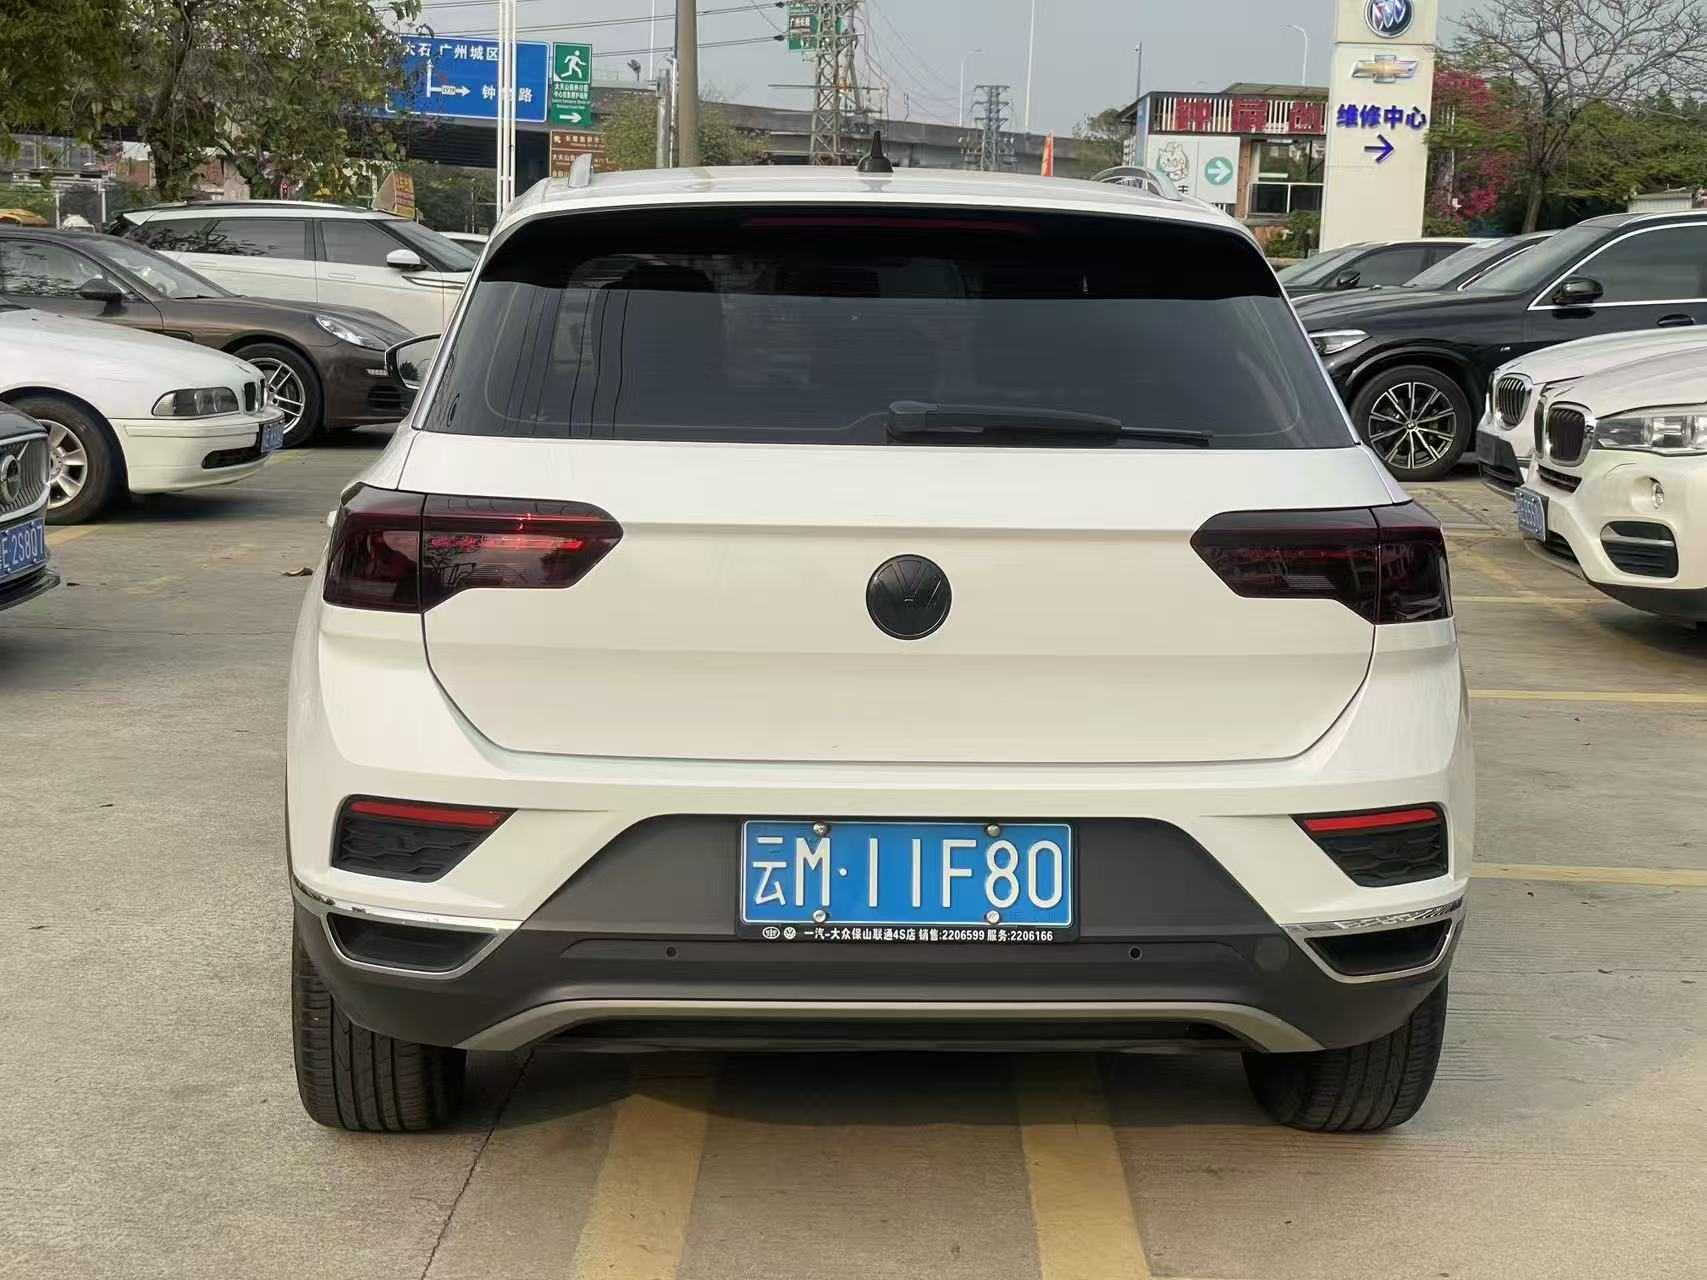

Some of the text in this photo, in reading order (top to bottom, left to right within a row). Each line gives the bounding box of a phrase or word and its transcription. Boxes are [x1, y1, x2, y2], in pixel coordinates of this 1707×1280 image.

[440, 43, 500, 61] 广州城区
[482, 85, 533, 103] 钟路
[1336, 104, 1427, 129] 维修中心
[918, 928, 985, 941] 销售:2206599
[986, 929, 1053, 942] 服务:2206166
